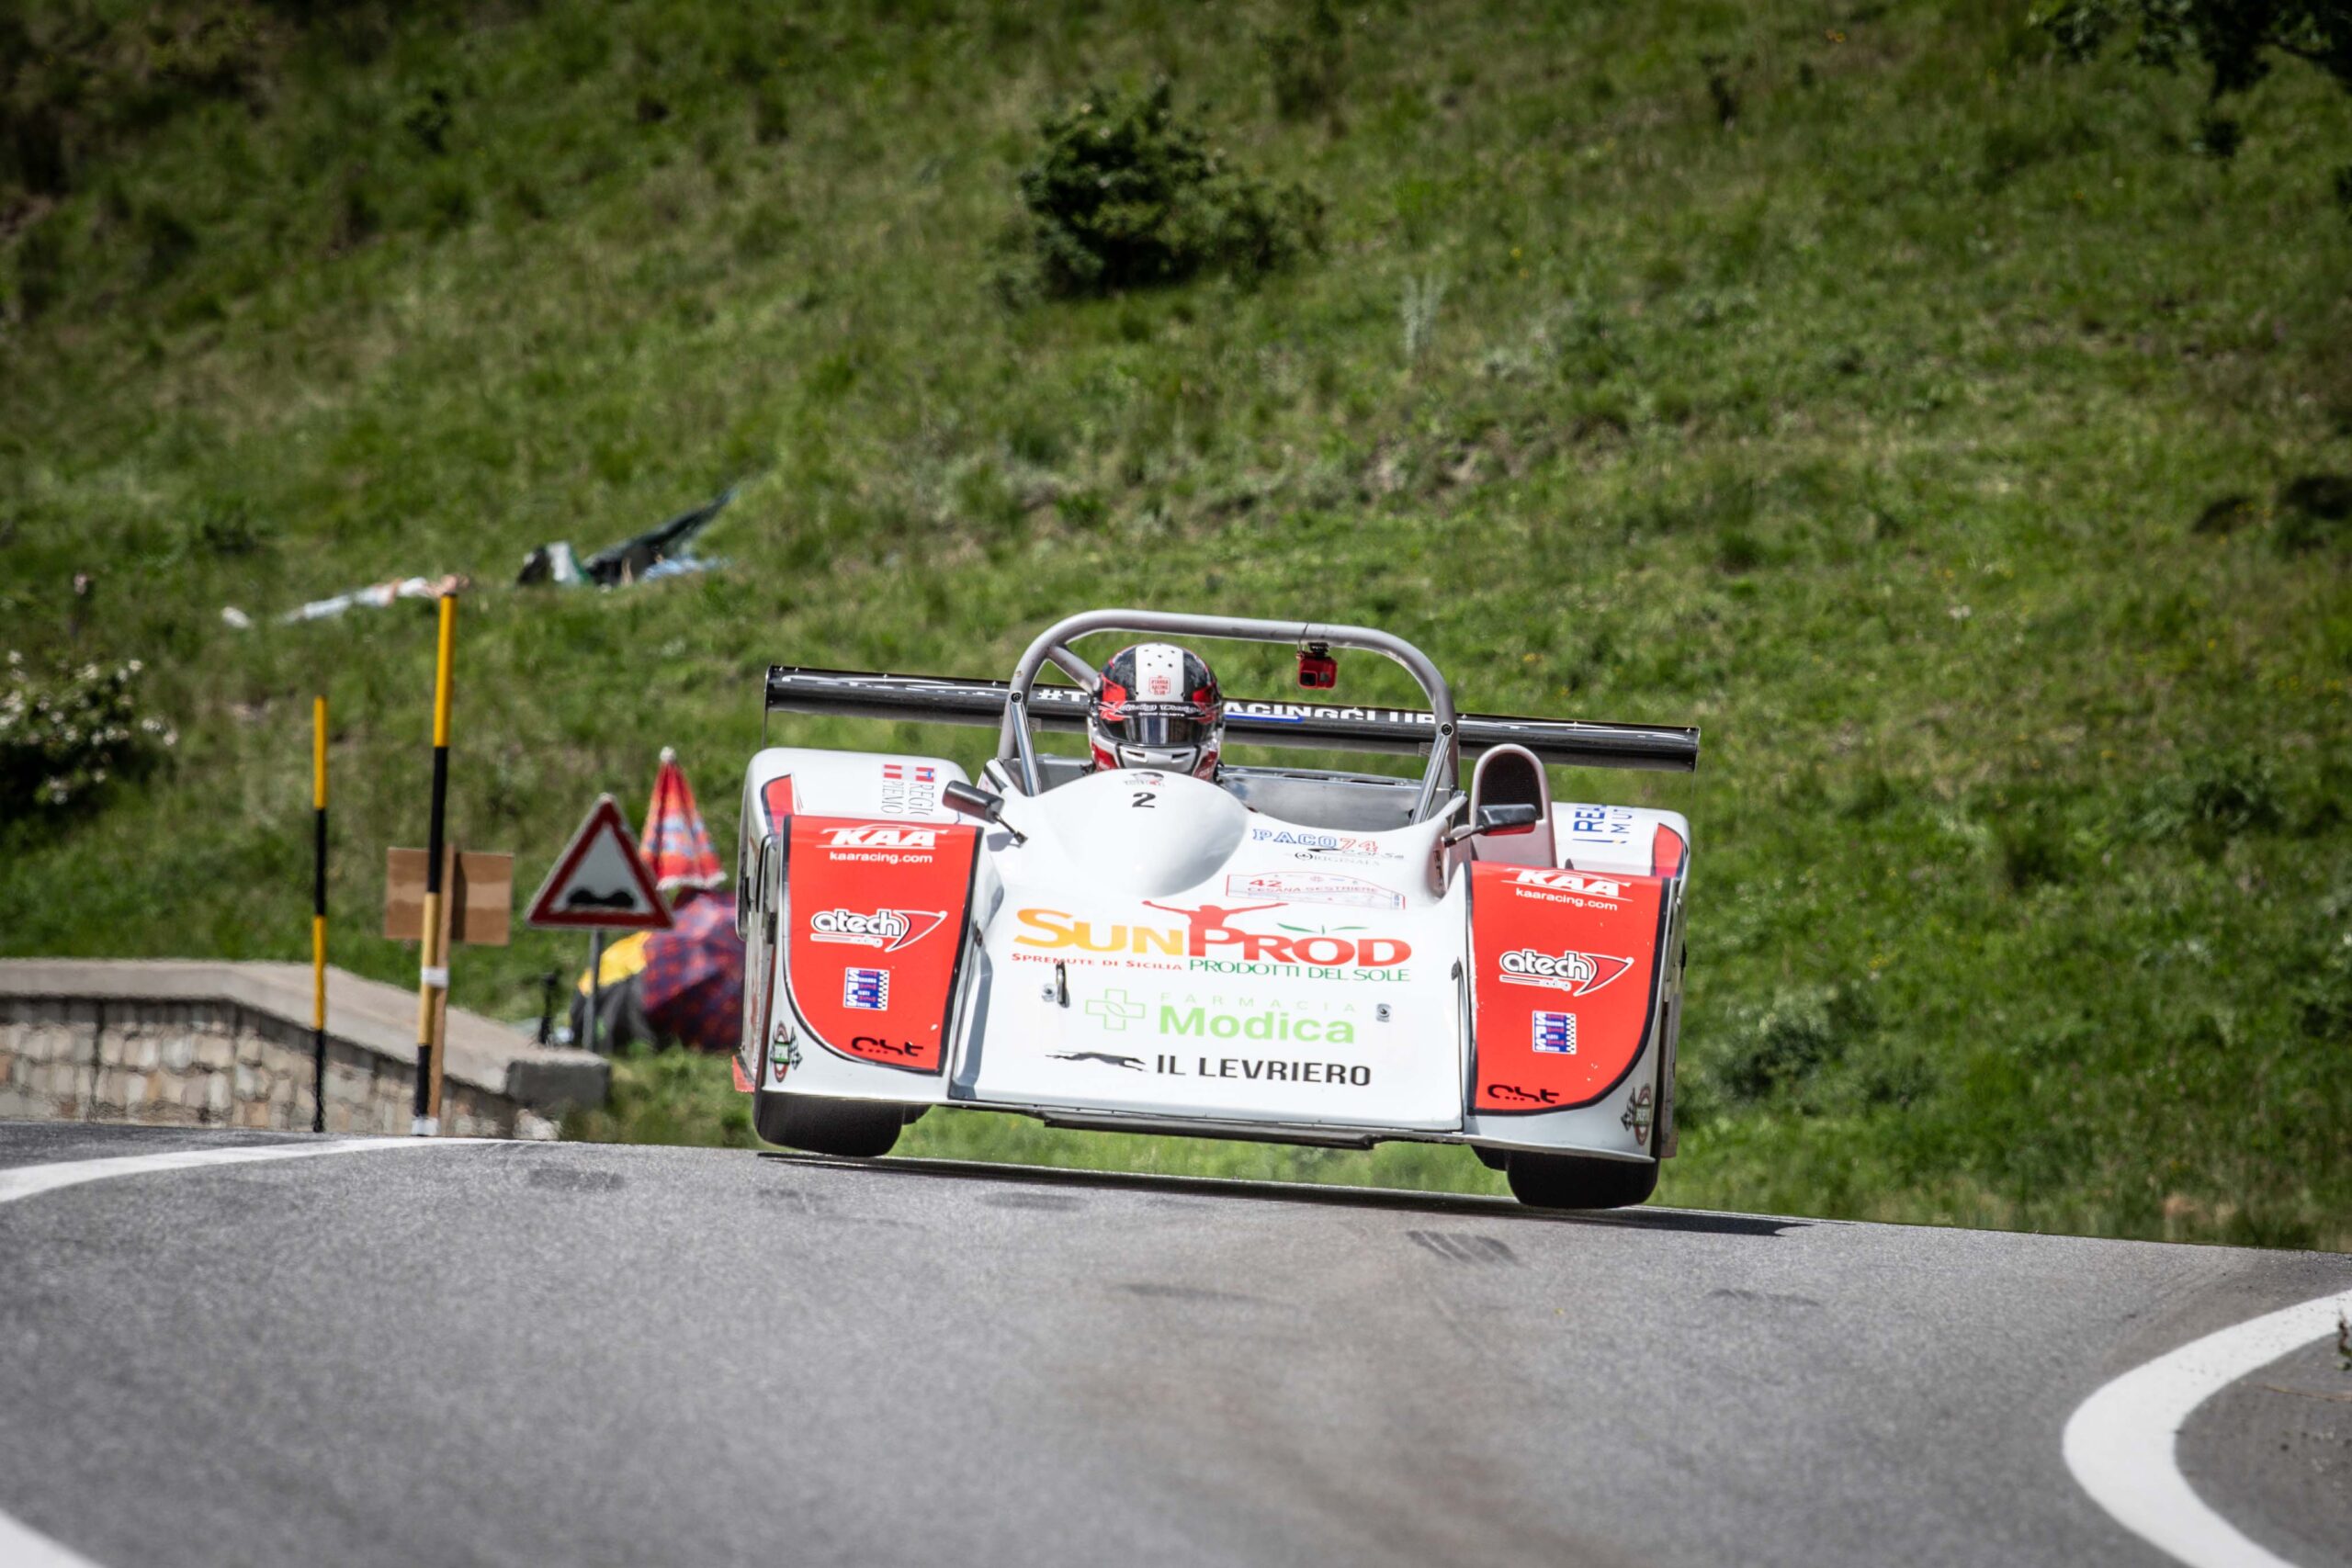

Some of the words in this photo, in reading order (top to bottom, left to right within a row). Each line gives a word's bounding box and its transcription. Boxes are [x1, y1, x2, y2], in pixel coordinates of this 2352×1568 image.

[1223, 702, 1339, 719] ACING
[1132, 792, 1156, 808] 2
[830, 829, 936, 847] KAA
[830, 852, 933, 864] kaaracing.com
[1249, 879, 1283, 888] 42
[1516, 870, 1620, 897] KAA
[1516, 887, 1618, 911] kaaracing.com
[811, 908, 903, 937] atech
[1189, 959, 1300, 977] PRODOTTI
[1308, 966, 1349, 981] DEL
[1353, 968, 1411, 982] SOLE
[1499, 949, 1591, 980] atech
[1160, 993, 1356, 1013] FARMACIA
[1159, 1005, 1355, 1043] Modica
[1157, 1055, 1186, 1076] IL
[1198, 1057, 1371, 1087] LEVRIERO
